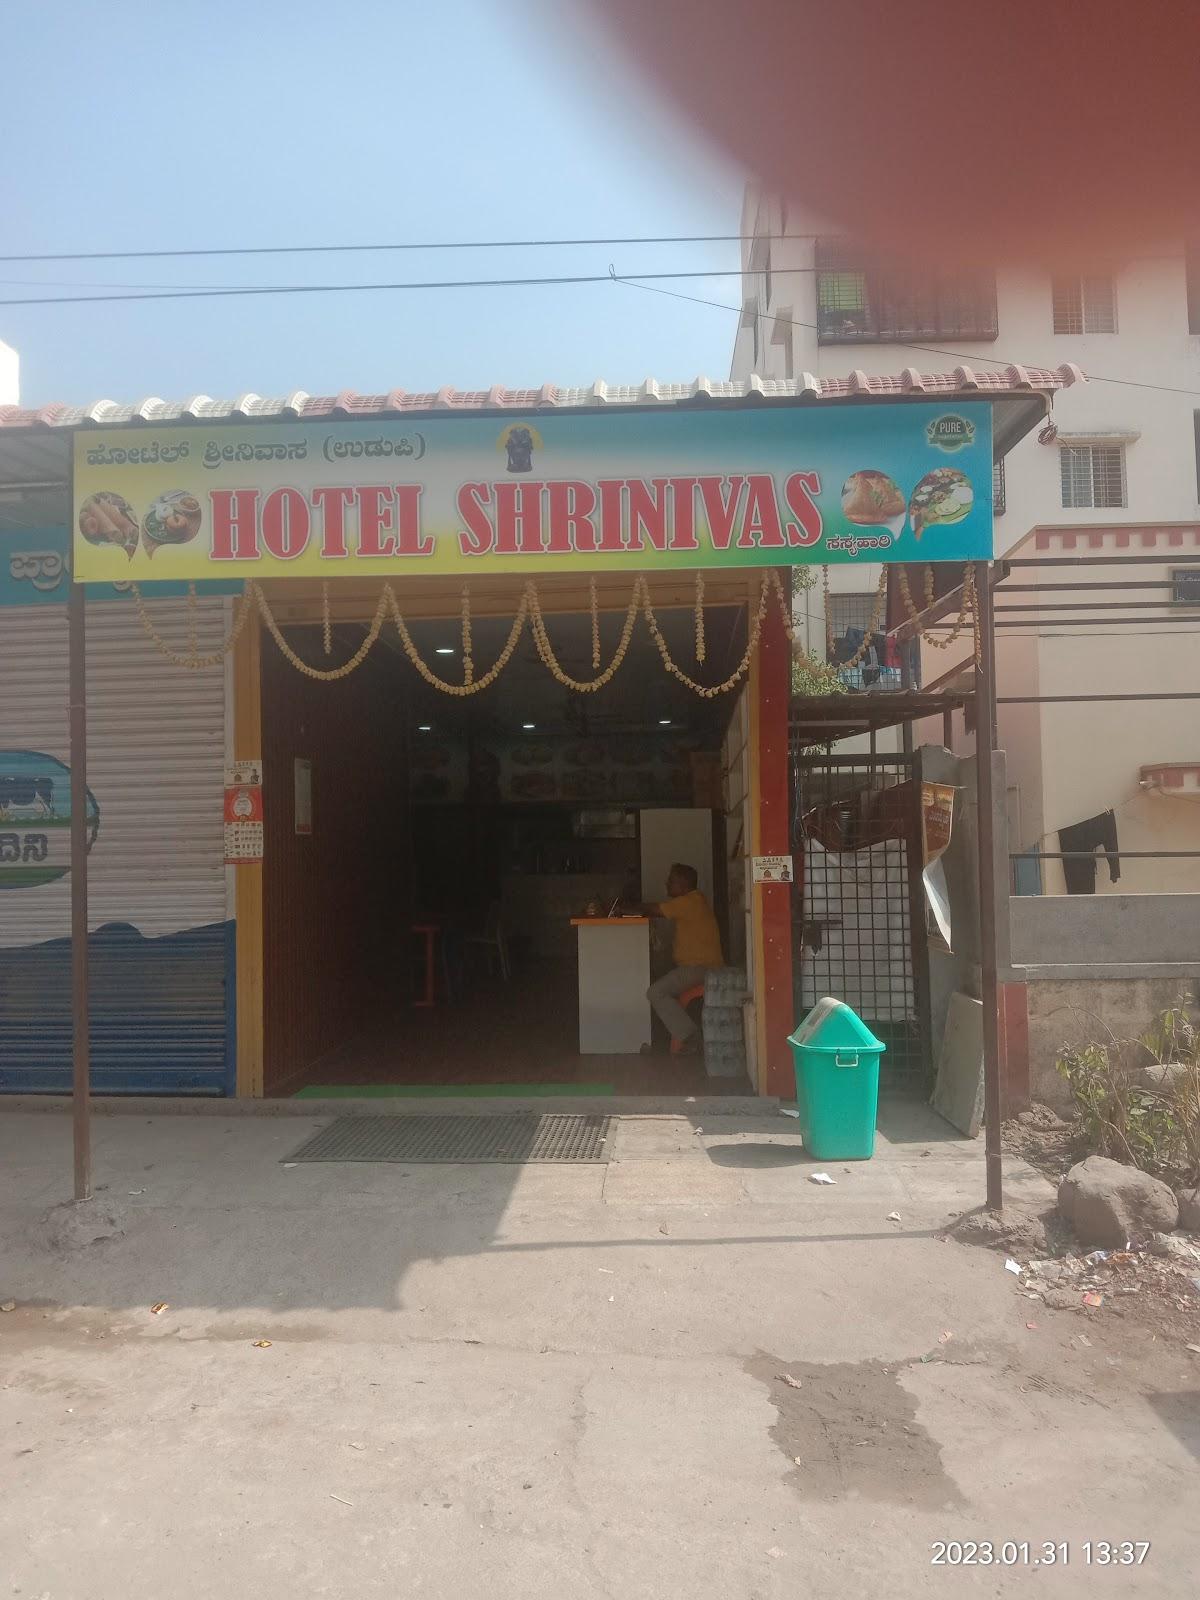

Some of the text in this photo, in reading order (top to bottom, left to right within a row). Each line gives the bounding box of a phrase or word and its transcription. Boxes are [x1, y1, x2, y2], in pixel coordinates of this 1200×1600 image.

[939, 421, 962, 433] PURE
[86, 432, 426, 469] ಹೋಟೆಲ್ ಶ್ರೀನಿವಾಸ (ಉಡುಪಿ)
[208, 472, 824, 561] HOTEL SHRINIVAS
[826, 533, 892, 557] ಸಸ್ಯಹಾರಿ
